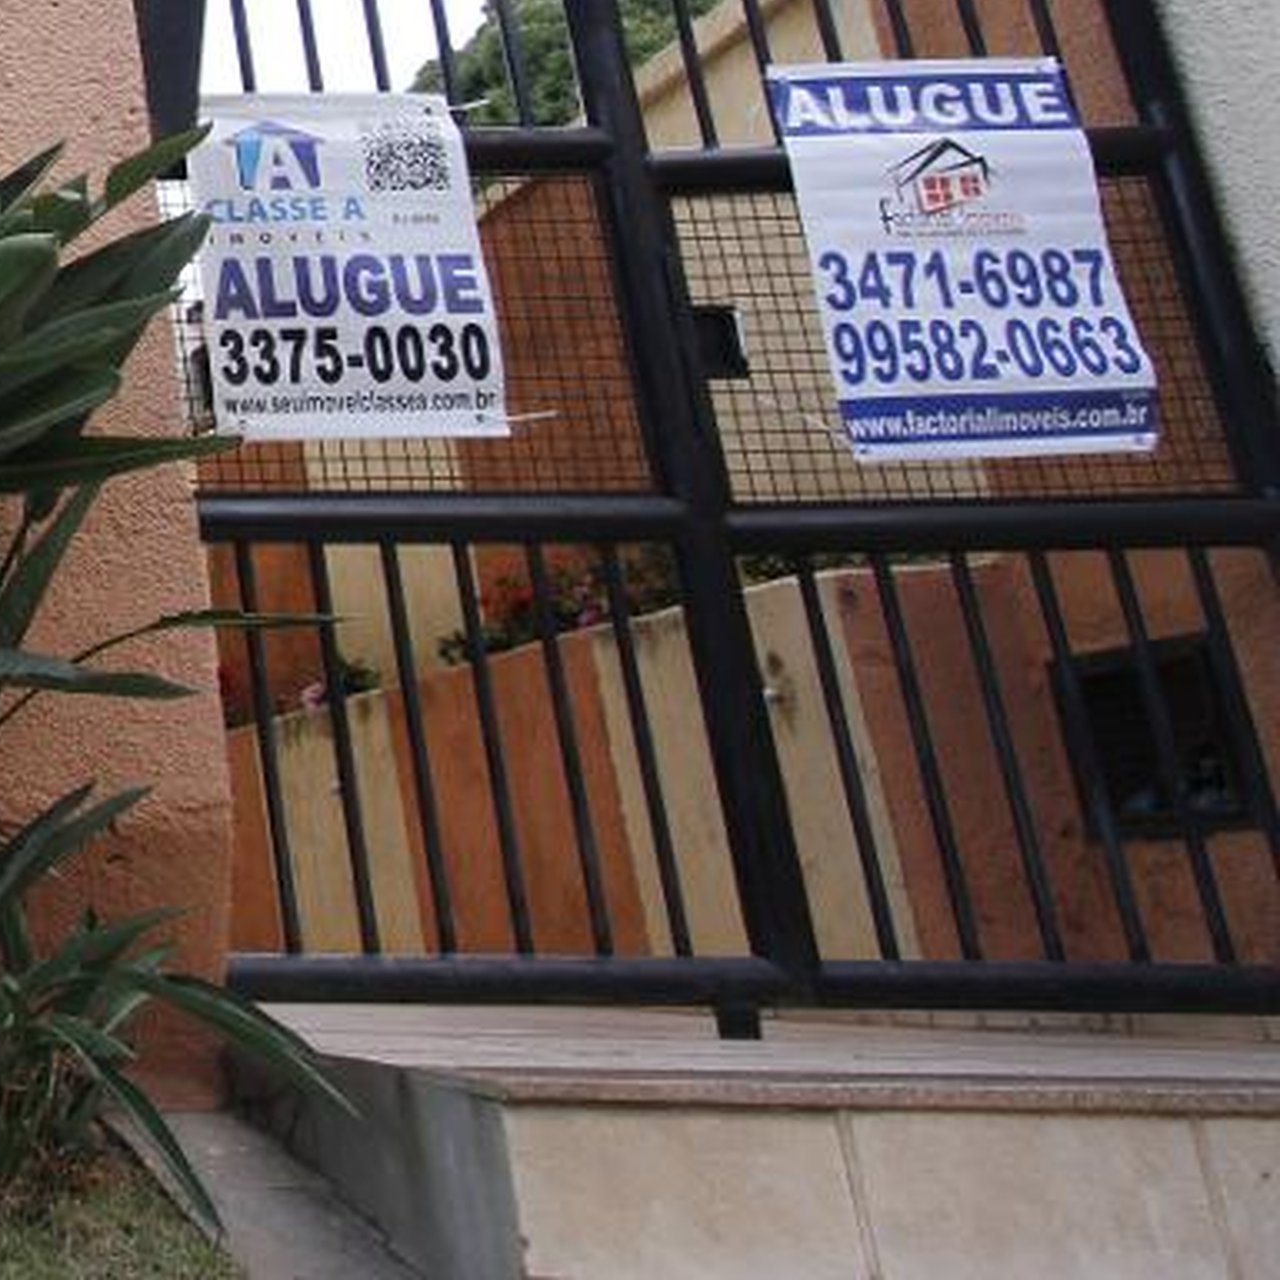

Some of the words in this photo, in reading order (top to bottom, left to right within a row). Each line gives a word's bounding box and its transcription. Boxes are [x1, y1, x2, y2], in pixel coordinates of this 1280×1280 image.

[786, 81, 1069, 129] ALUGUE
[206, 197, 328, 224] CLASSE
[343, 196, 365, 220] A
[213, 253, 484, 320] ALUGUE
[818, 249, 1106, 312] 3471-6987
[218, 322, 491, 385] 3375-0030
[832, 316, 1142, 386] 99582-0663
